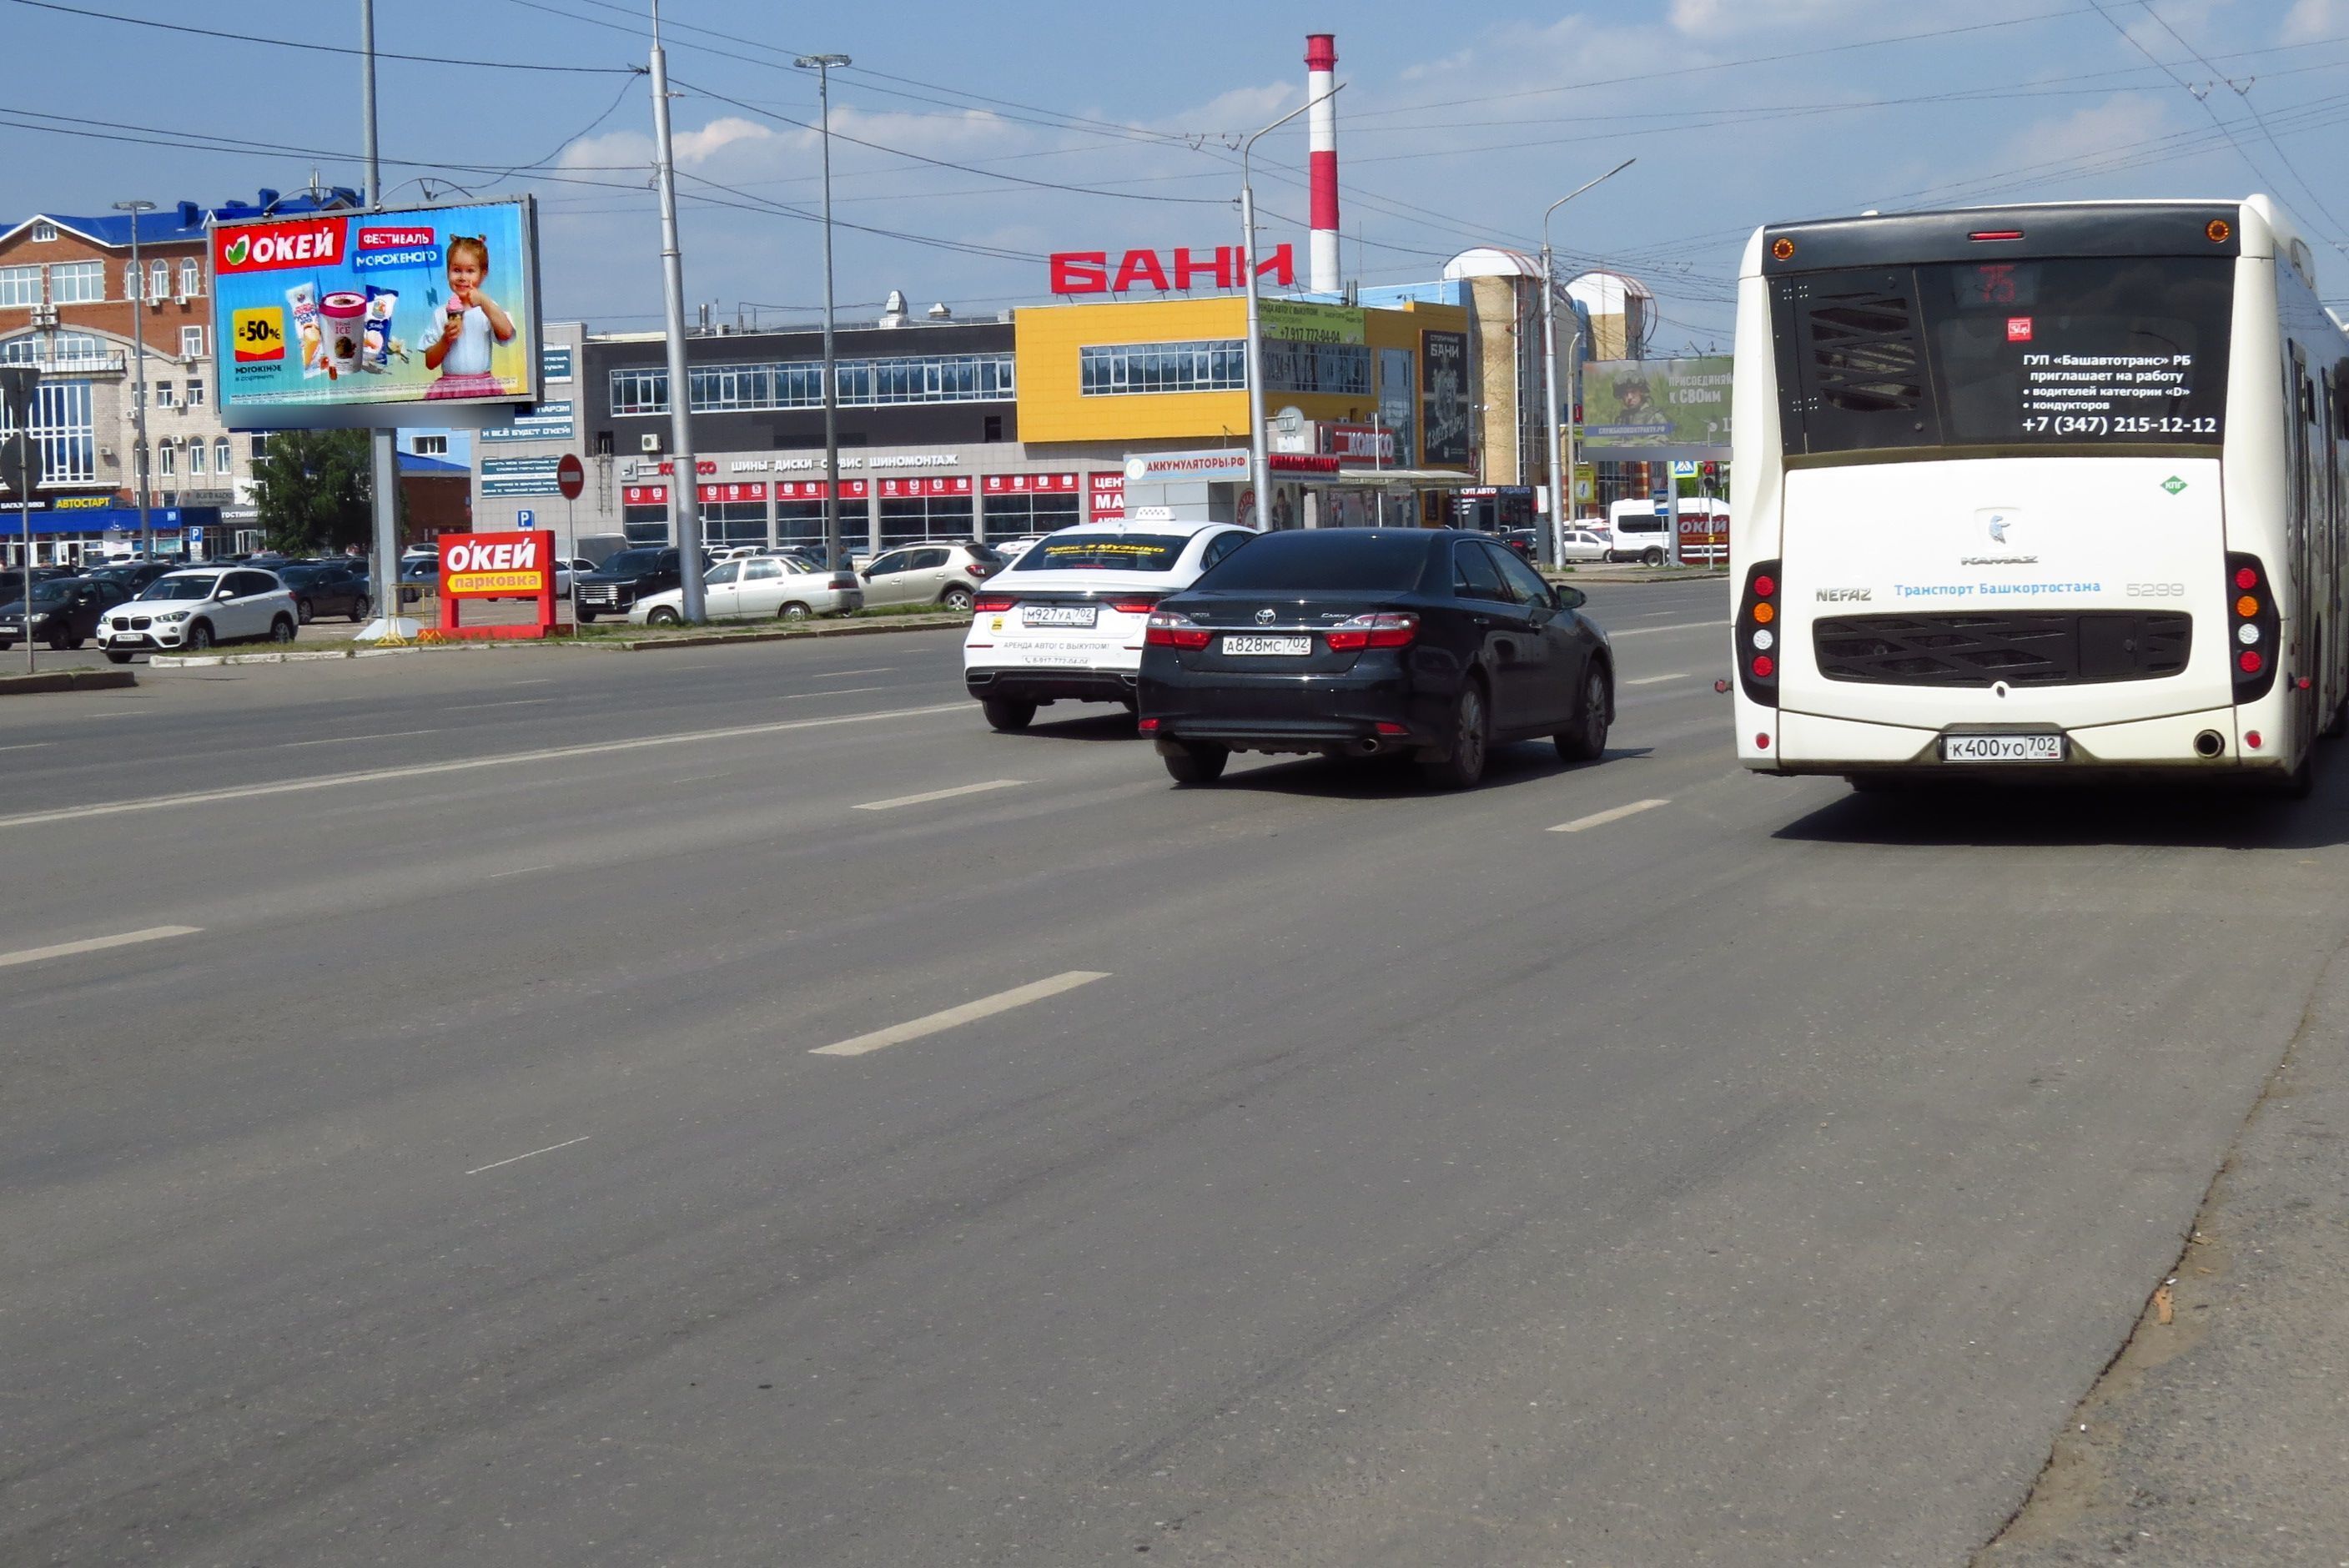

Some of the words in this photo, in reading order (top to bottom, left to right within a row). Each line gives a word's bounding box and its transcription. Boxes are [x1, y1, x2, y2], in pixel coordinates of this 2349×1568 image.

[253, 227, 334, 263] О'КЕЙ
[363, 233, 430, 245] ФЕСТИВАЛЬ
[356, 250, 437, 267] МОРОЖЕНОГО
[1050, 244, 1292, 294] БАНИ
[1259, 304, 1273, 314] РЕНДА
[1290, 327, 1305, 340] 917
[1430, 344, 1459, 358] БАНИ
[2023, 354, 2050, 365] ГУП
[2053, 354, 2169, 367] «Башавтотранс»
[2173, 355, 2191, 365] РБ
[1669, 373, 1733, 387] ПРИСОЕДИНЯЙ
[2030, 372, 2112, 383] приглашает
[2115, 373, 2133, 381] на
[2136, 370, 2184, 383] работу
[2033, 386, 2097, 396] водителей
[2100, 388, 2162, 398] категории
[2032, 401, 2110, 411] кондукторов
[2022, 417, 2049, 432] +7
[2055, 416, 2108, 435] (347)
[2114, 417, 2216, 433] 215-12-12
[659, 461, 717, 475] КОСО
[731, 460, 767, 471] ШИНЫ
[774, 459, 812, 471] ДИСКИ
[820, 458, 863, 469] СВИС
[869, 455, 958, 469] ШИНОМОНТАЖ
[1146, 457, 1245, 472] АККУМУЛЯТОРЫ.РФ
[55, 498, 110, 509] АВТОСТАРТ
[1095, 494, 1124, 509] МА
[447, 538, 536, 571] О'КЕЙ
[455, 574, 538, 591] парковка
[2126, 583, 2185, 596] 5299
[1816, 588, 1872, 602] NEFAZ
[1894, 585, 1974, 597] Транспорт
[1979, 583, 2101, 596] Башкортостана
[1075, 609, 1092, 618] 702
[1003, 641, 1032, 650] АРЕНДА
[1066, 641, 1109, 651] ВЫКУПОМ!
[1226, 637, 1282, 652] А828МС
[1286, 637, 1307, 649] 702
[1953, 739, 2025, 756] К400УО
[2028, 737, 2055, 751] 702
